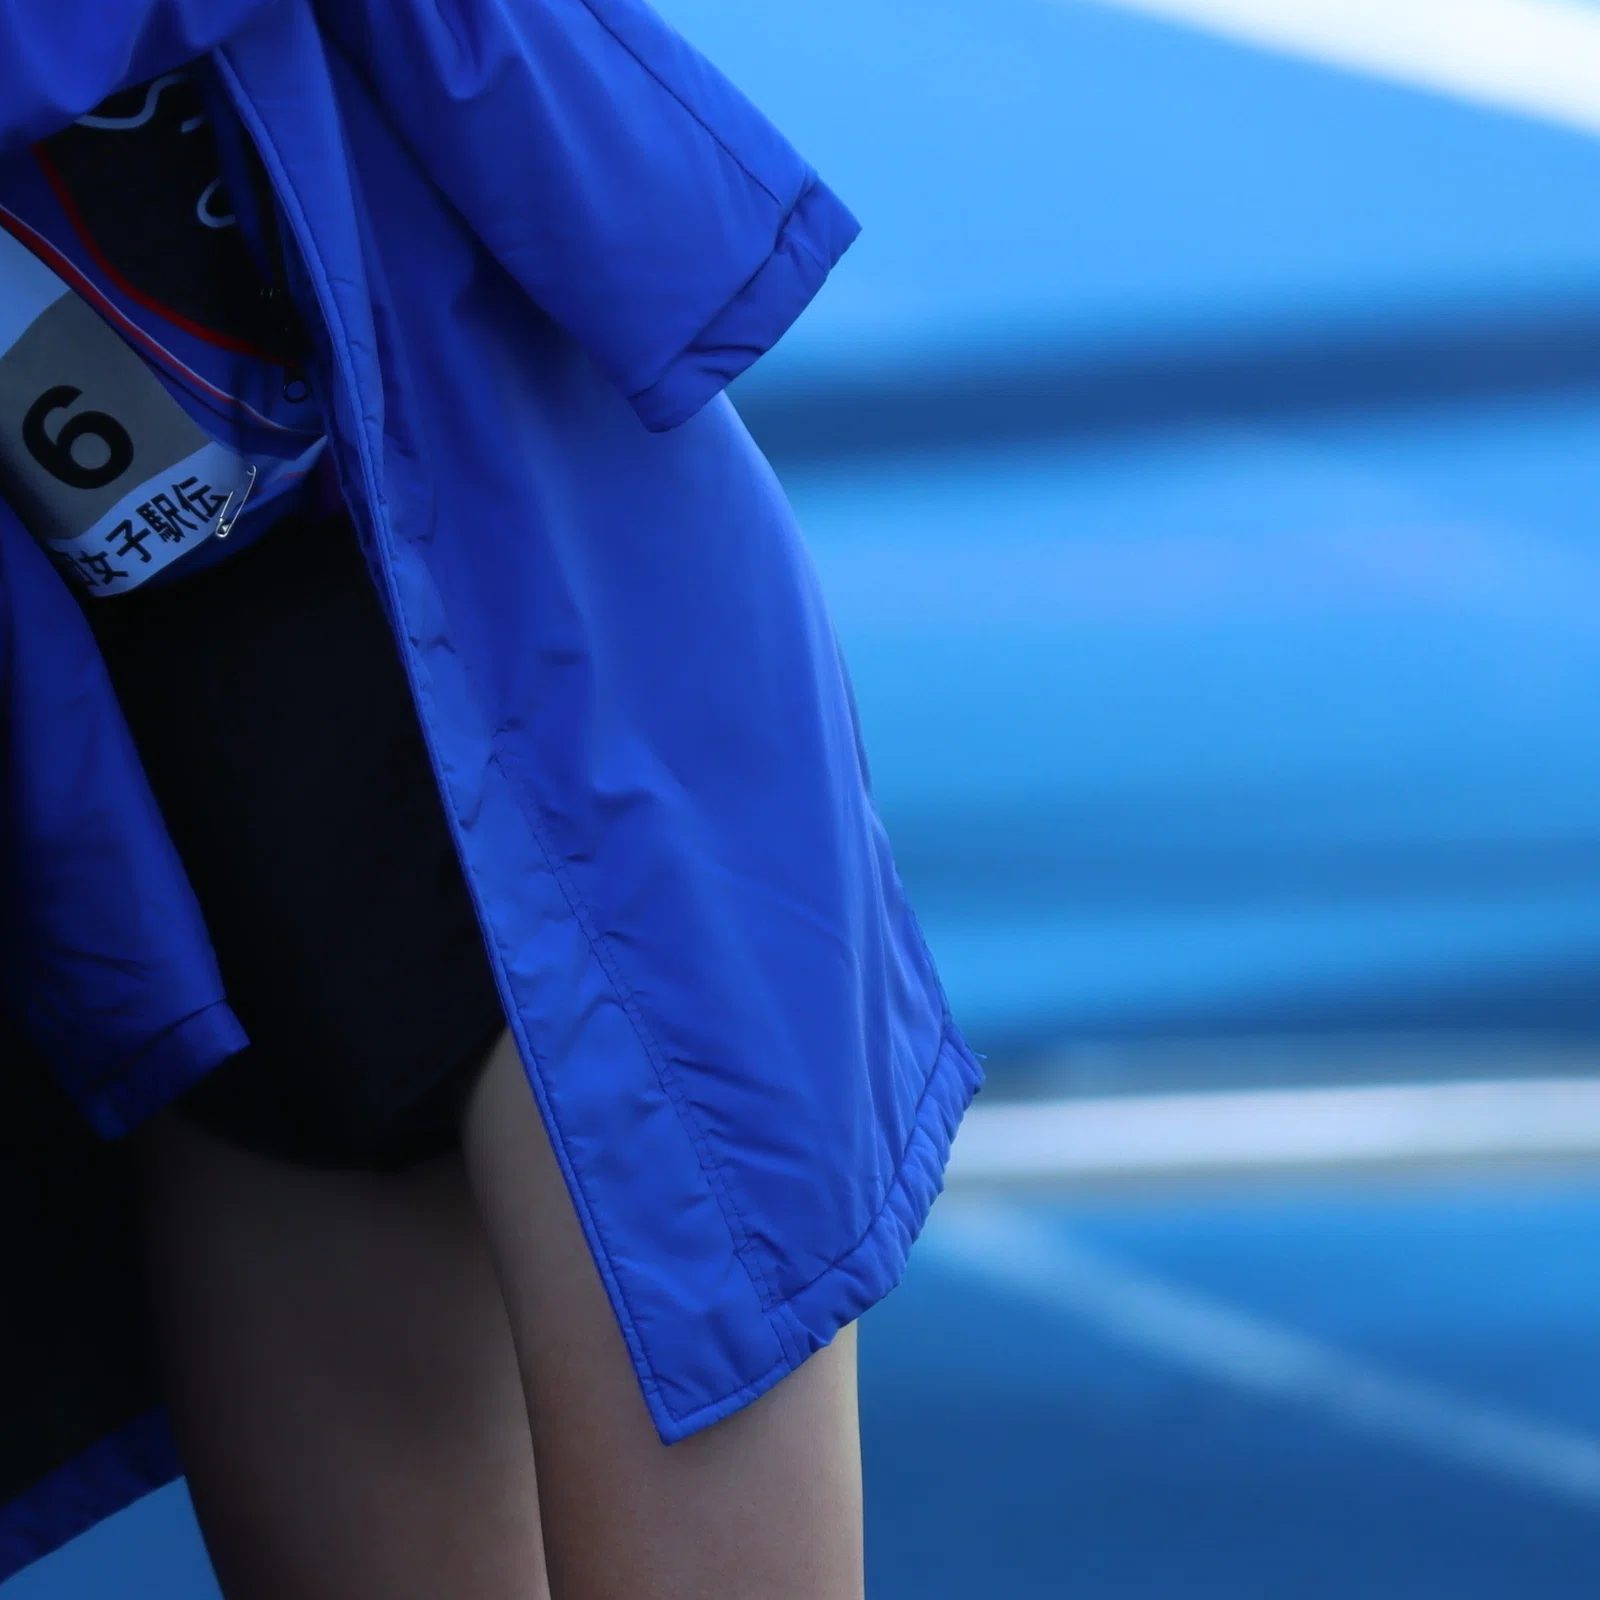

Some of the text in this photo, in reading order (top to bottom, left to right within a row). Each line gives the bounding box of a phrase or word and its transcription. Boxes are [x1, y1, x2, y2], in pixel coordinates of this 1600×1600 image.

[22, 384, 134, 490] 6
[64, 475, 228, 586] 女子駅伝
